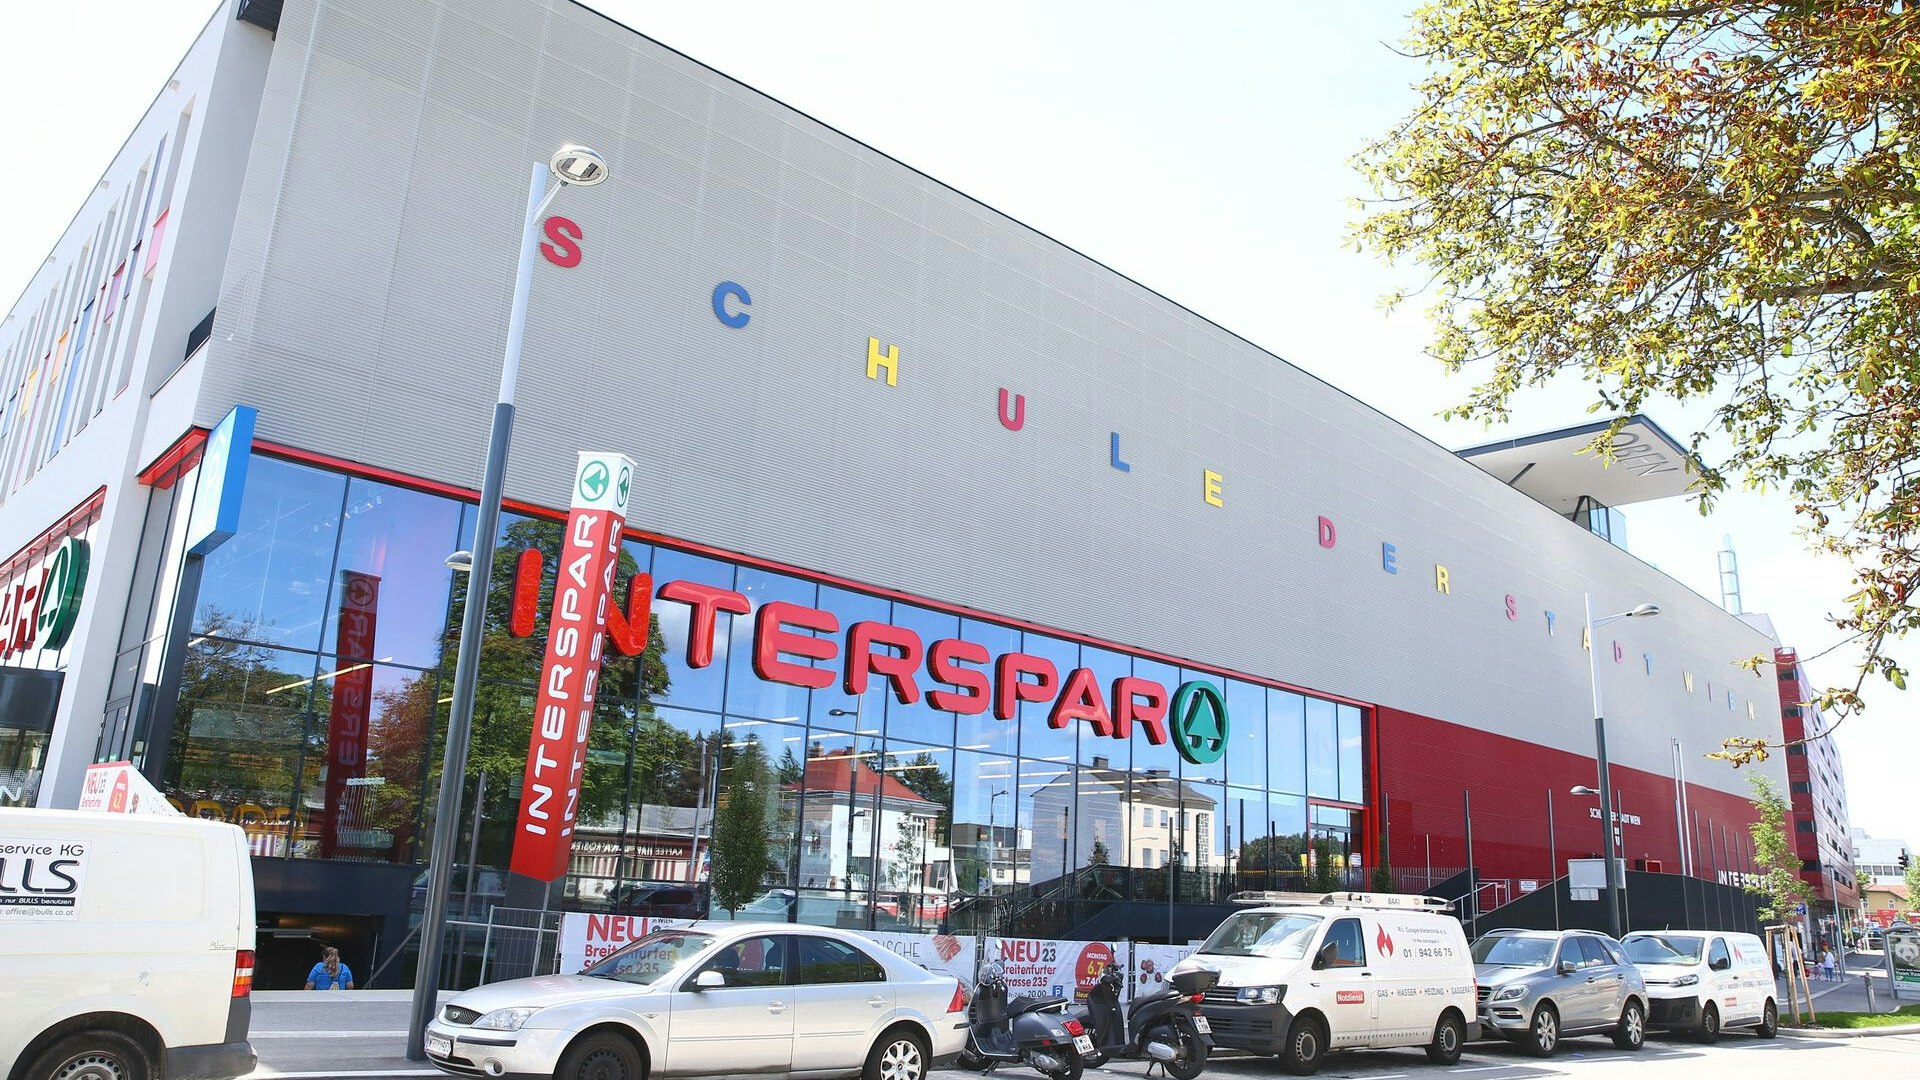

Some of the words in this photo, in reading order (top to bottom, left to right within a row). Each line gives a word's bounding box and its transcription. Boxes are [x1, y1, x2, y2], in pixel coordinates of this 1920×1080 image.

[540, 215, 1223, 508] SCHULE
[1318, 515, 1450, 595] DER
[1505, 594, 1653, 676] STADT
[1683, 671, 1755, 720] WIEN
[525, 512, 599, 836] INTERSPAR
[561, 518, 622, 837] INTERSPAR
[60, 844, 84, 856] KG
[586, 914, 648, 942] NEU
[1001, 940, 1040, 962] NEU
[1042, 948, 1056, 962] 23
[1086, 952, 1107, 960] MONTAG
[1403, 948, 1412, 957] 01
[1419, 948, 1432, 957] 942
[1433, 948, 1443, 957] 66
[1443, 948, 1453, 957] 75
[1032, 977, 1048, 987] 235
[1338, 993, 1363, 1002] Notdienst
[1377, 989, 1388, 998] GAS
[1424, 988, 1444, 996] HEIZUNG
